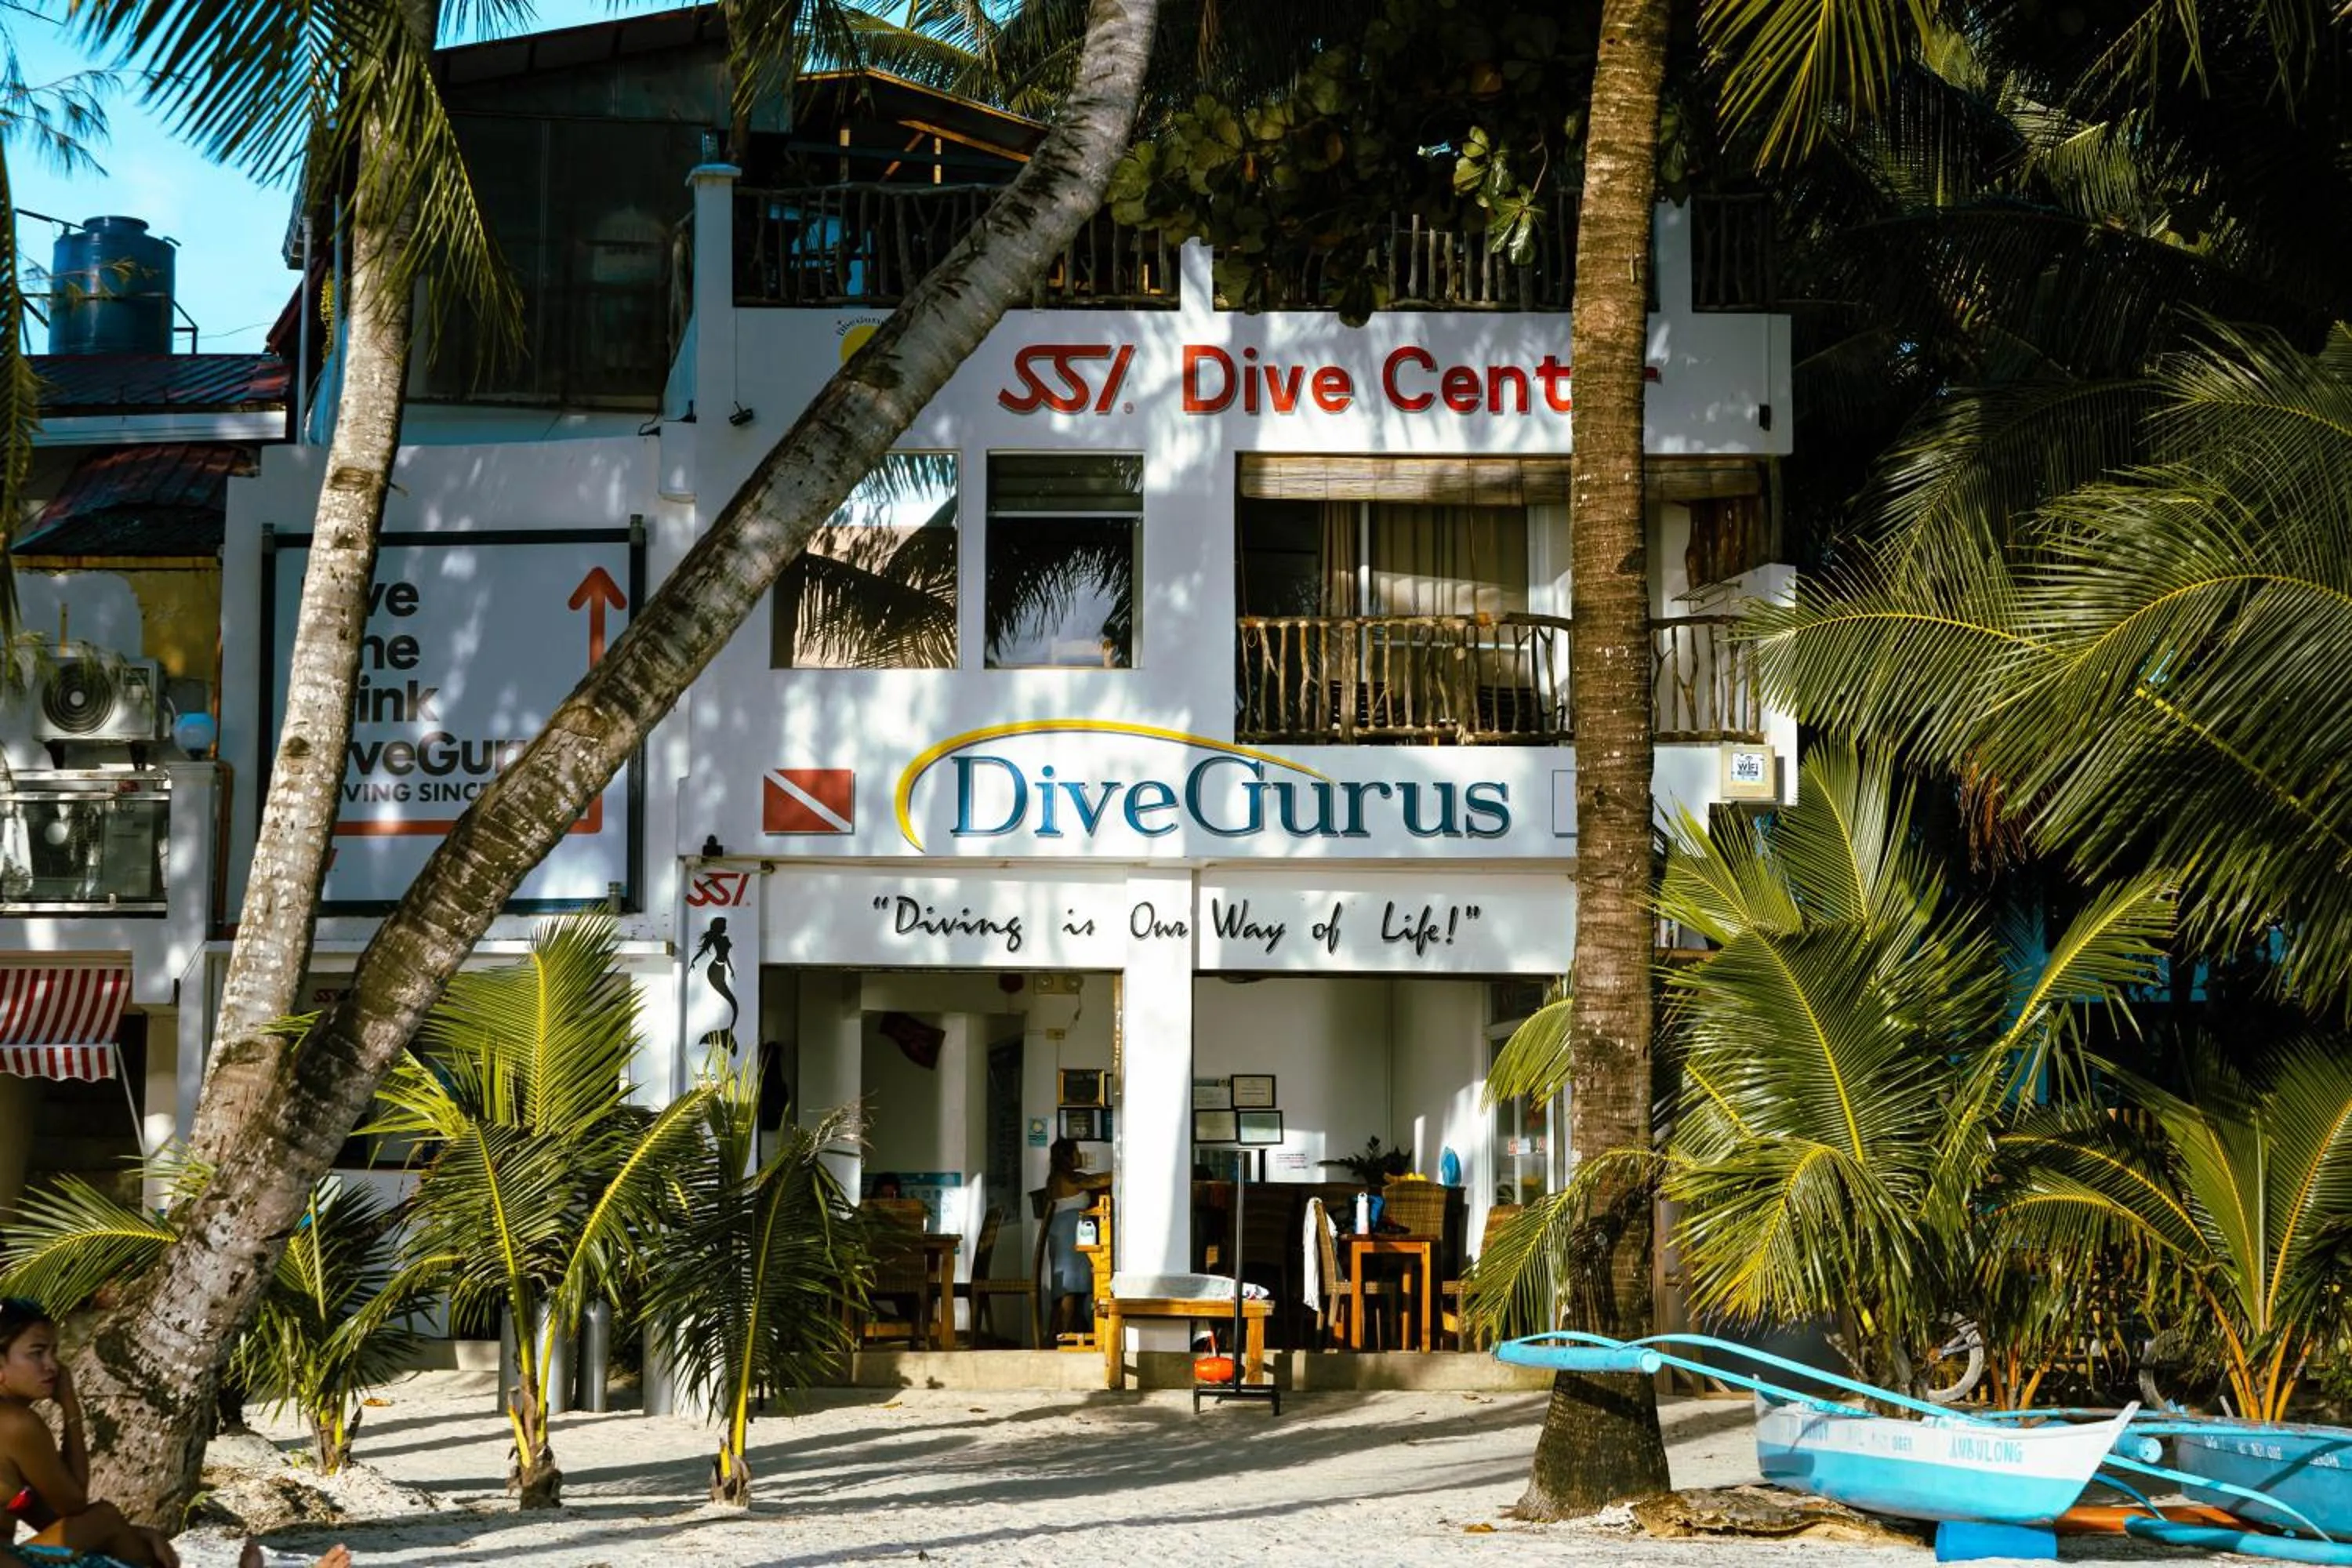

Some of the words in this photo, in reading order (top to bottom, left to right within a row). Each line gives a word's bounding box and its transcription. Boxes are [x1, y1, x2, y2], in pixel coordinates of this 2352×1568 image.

[998, 344, 1135, 414] SSI
[1182, 344, 1355, 415] Dive
[1382, 345, 1662, 414] Cent
[357, 675, 439, 722] ink
[349, 731, 527, 776] veGur
[343, 782, 411, 803] VING
[419, 782, 484, 802] SINC
[950, 754, 1511, 838] DiveGurus
[1062, 908, 1096, 936] is
[1130, 901, 1189, 940] Our
[1212, 898, 1287, 955] Way
[1312, 901, 1343, 955] of
